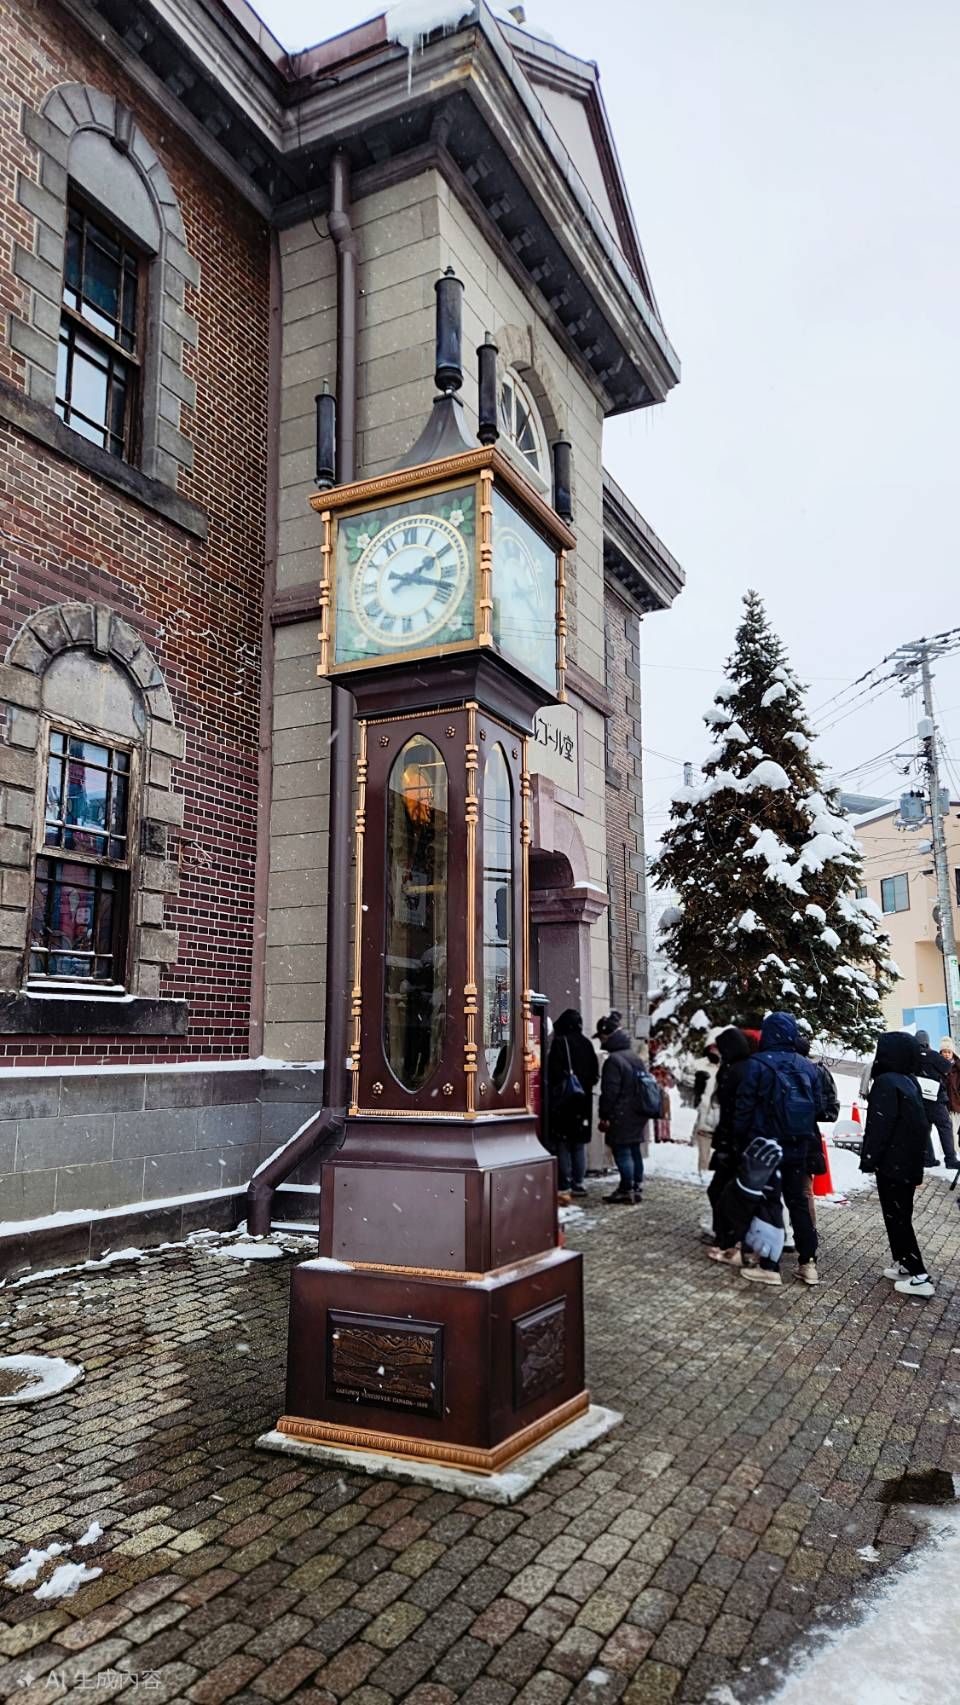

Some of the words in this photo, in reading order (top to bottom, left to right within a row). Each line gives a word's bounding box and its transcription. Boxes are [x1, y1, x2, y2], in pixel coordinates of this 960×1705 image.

[402, 527, 417, 545] XII
[425, 529, 436, 546] I
[383, 537, 397, 557] XI
[440, 564, 457, 578] III
